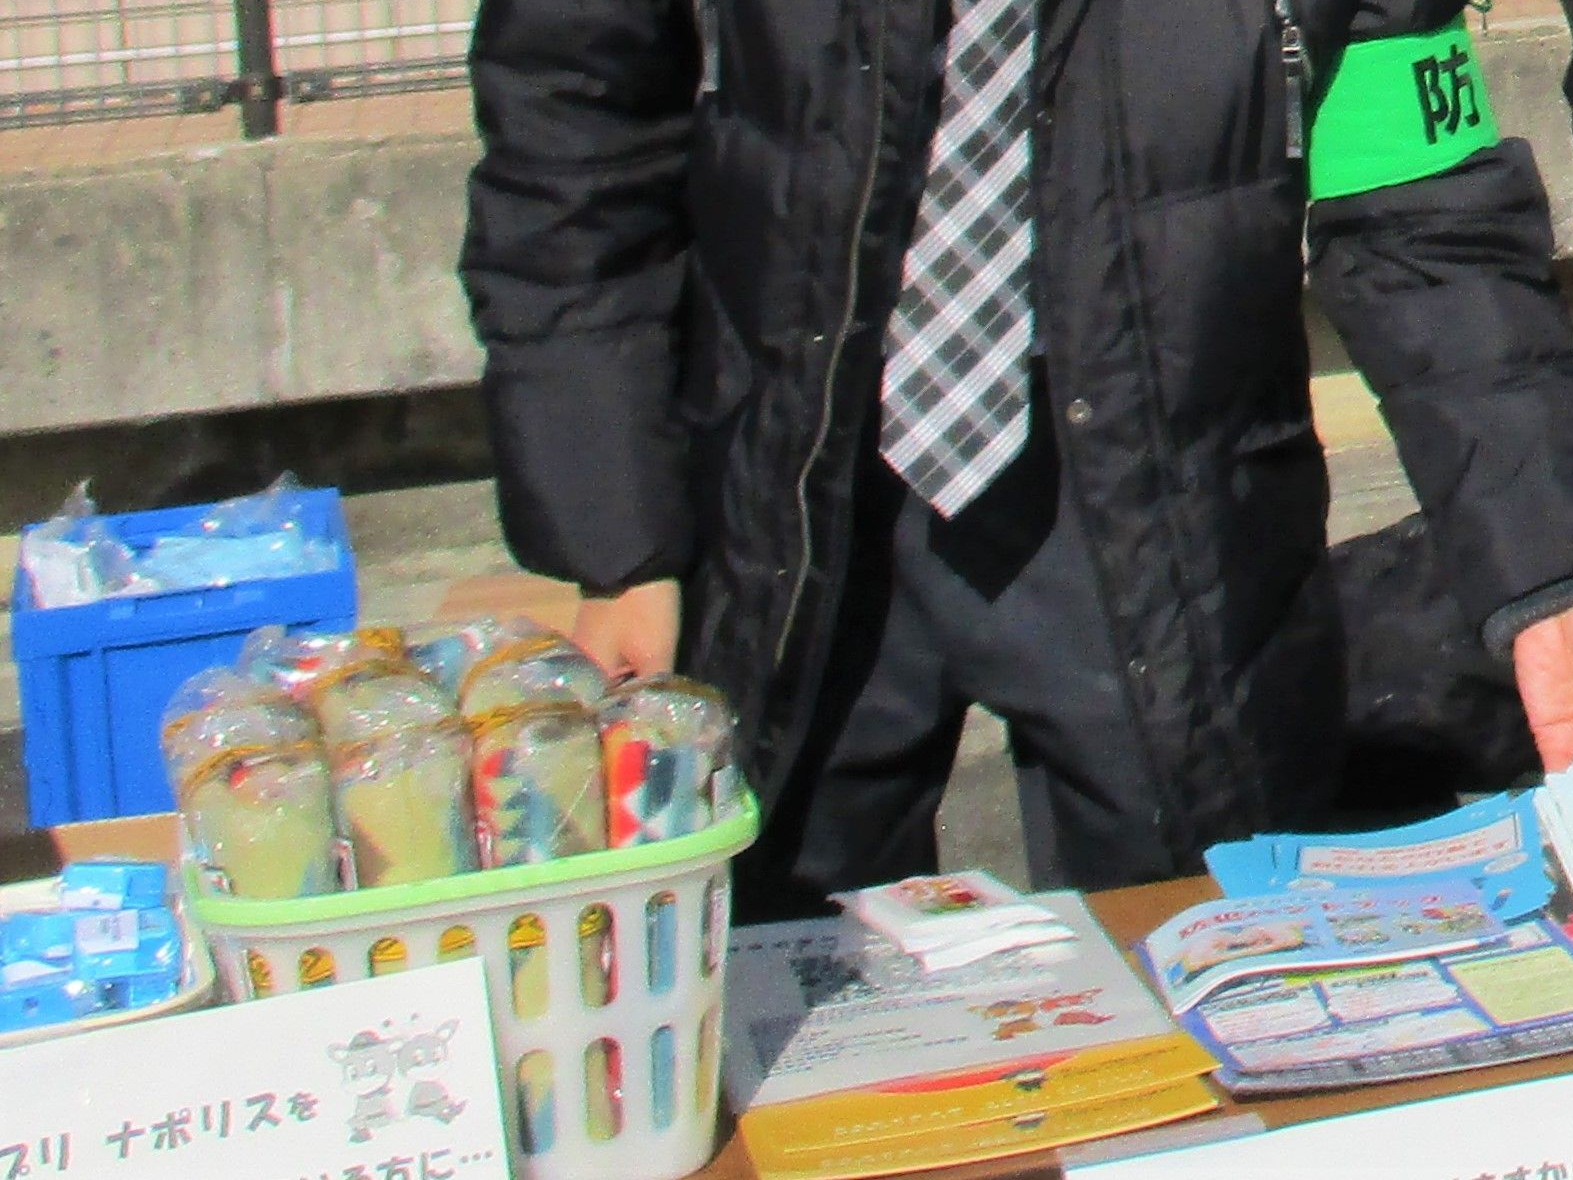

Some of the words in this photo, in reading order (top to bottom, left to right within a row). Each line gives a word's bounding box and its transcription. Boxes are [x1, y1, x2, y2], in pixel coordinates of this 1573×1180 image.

[1412, 43, 1481, 145] 防
[105, 1091, 319, 1160] ナポリスを
